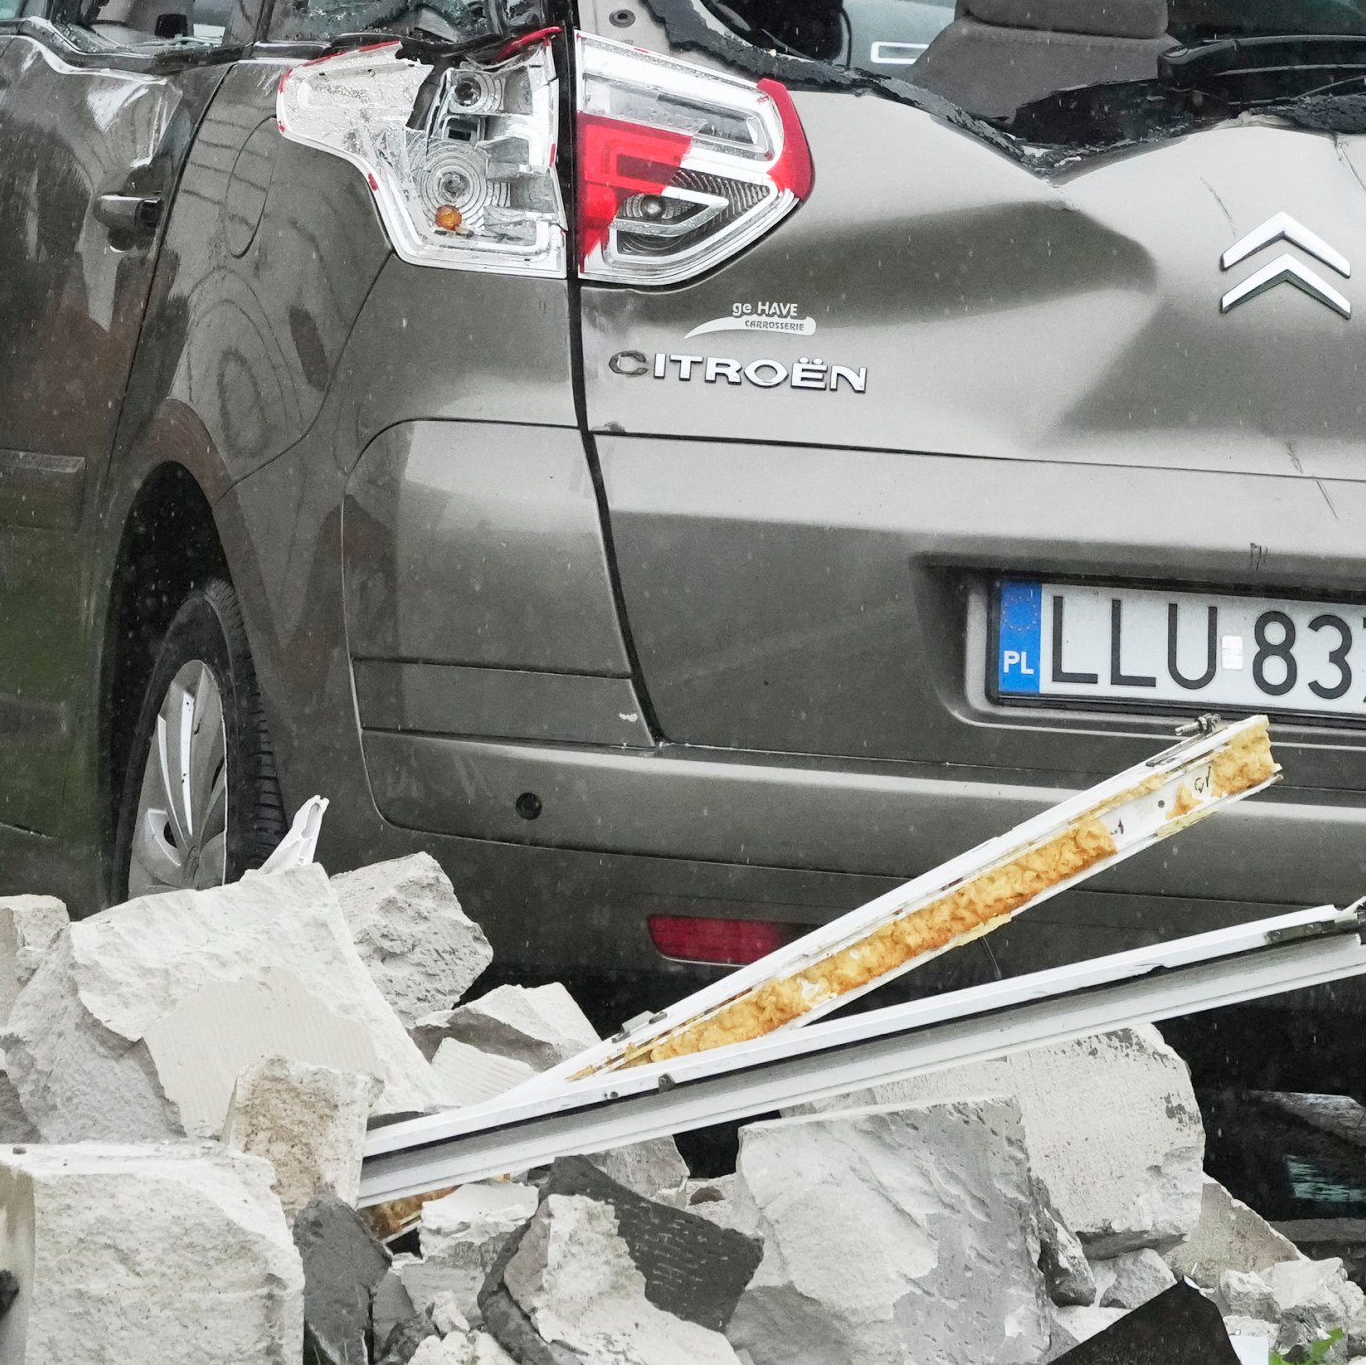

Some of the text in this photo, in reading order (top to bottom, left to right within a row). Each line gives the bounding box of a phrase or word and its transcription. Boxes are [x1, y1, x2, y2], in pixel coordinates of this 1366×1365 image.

[757, 301, 798, 316] HAVE
[744, 319, 805, 331] CARROSSERIE
[609, 350, 868, 394] CITROËN
[1052, 595, 1218, 690] LLU
[1003, 650, 1035, 675] PL
